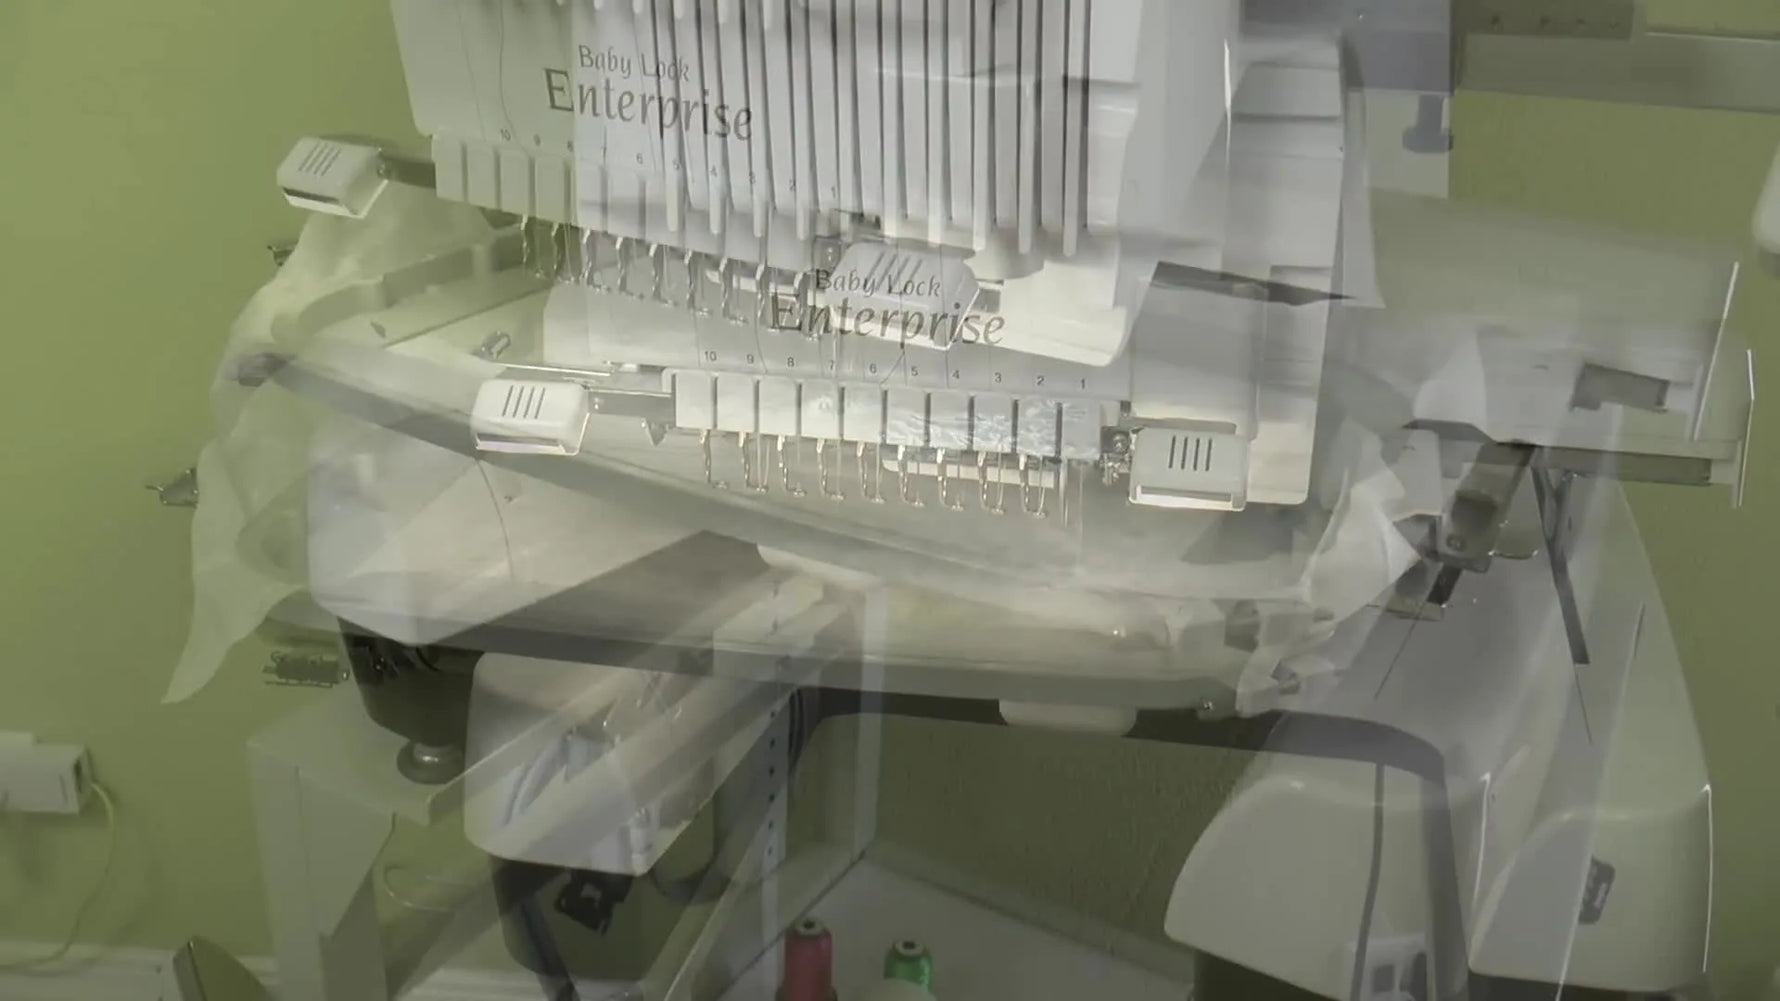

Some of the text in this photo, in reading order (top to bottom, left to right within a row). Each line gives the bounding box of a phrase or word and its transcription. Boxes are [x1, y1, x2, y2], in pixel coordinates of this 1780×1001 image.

[578, 45, 631, 79] Baby
[545, 68, 753, 141] Enterprise
[500, 129, 511, 141] 10
[636, 153, 643, 165] 6
[816, 269, 942, 297] Baby Lock
[771, 293, 1004, 347] Enterprise
[705, 350, 1087, 391] 10 9 8 7 6 5 4 3 2 1
